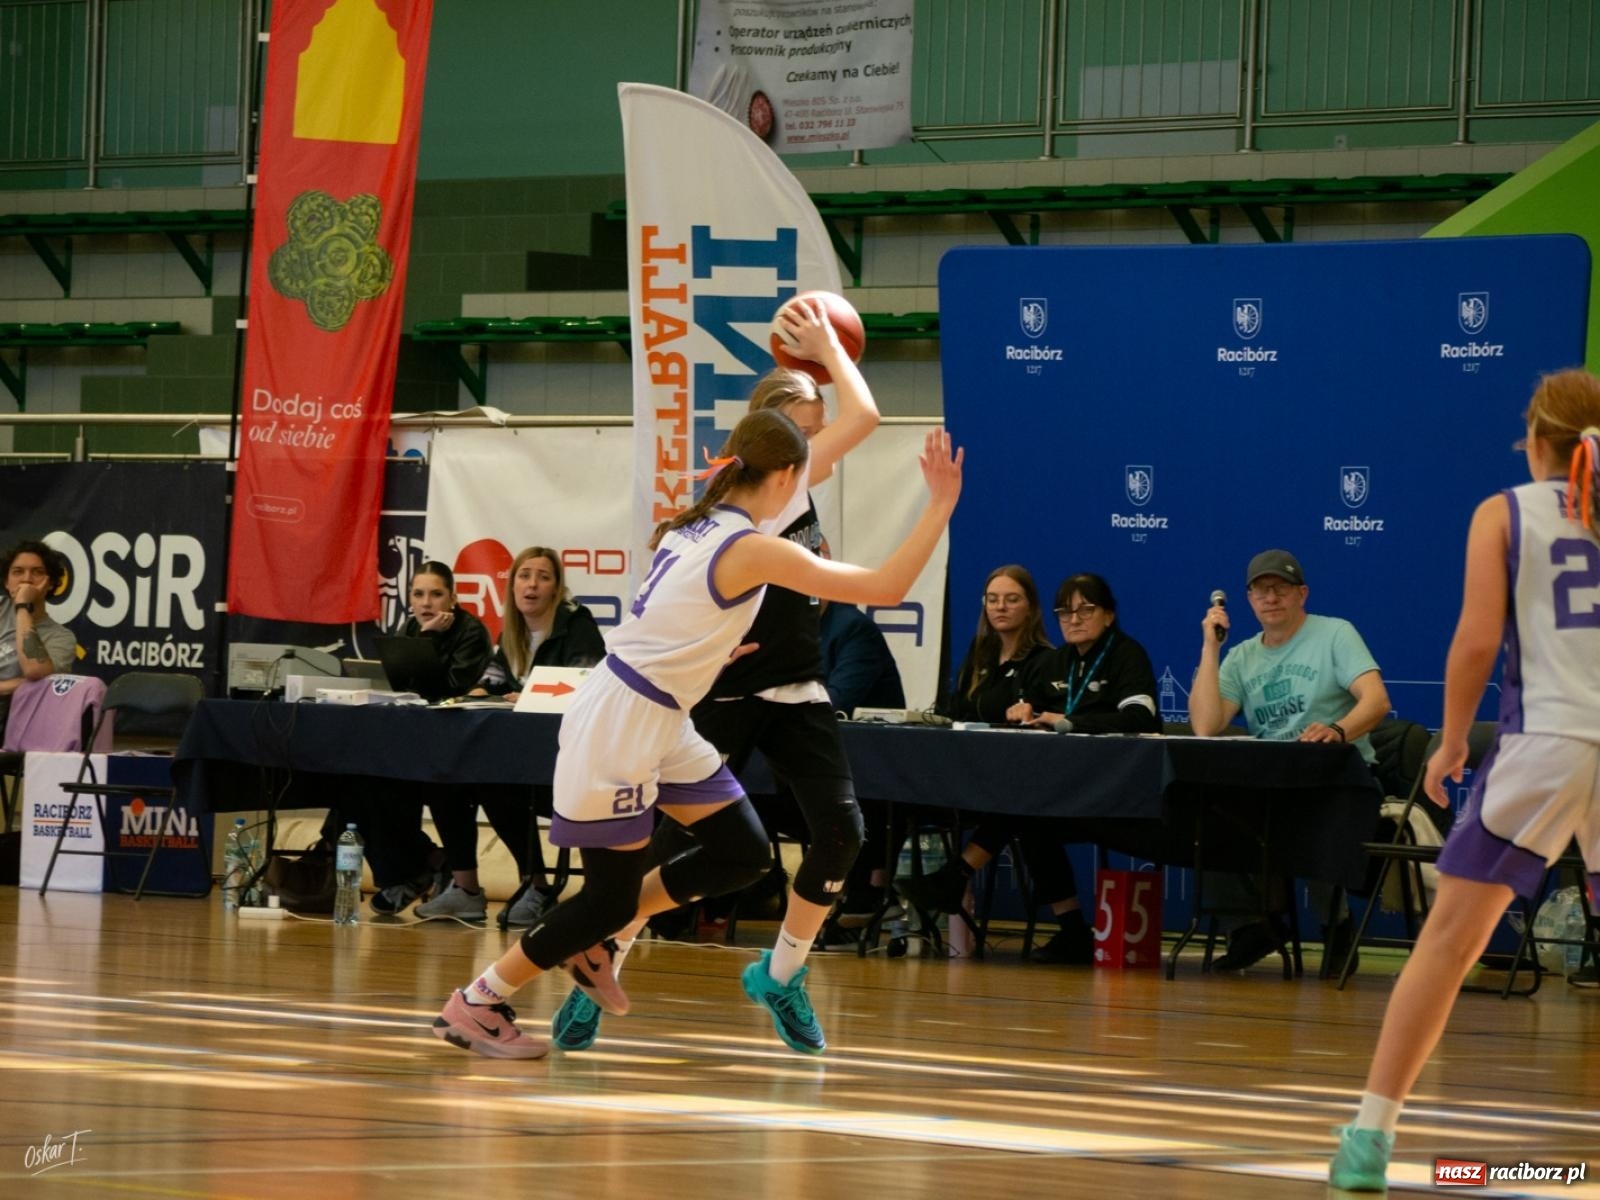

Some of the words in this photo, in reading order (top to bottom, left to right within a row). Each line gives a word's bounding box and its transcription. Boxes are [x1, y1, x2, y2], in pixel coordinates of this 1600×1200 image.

[836, 14, 911, 35] cuerniczych
[730, 44, 785, 56] Pcownik
[786, 70, 837, 82] Czekamy
[842, 68, 859, 79] na
[863, 63, 899, 77] Ciebie!
[1006, 345, 1063, 360] Racibórz
[1217, 347, 1277, 362] Racibórz
[1440, 341, 1504, 358] Racibórz
[253, 389, 322, 423] Dodaj
[330, 396, 362, 419] coś
[249, 421, 278, 442] od
[279, 424, 335, 449] siebie
[1111, 513, 1168, 529] Racibórz
[1324, 516, 1384, 531] Racibórz
[97, 634, 204, 668] RACIBÓRZ
[1254, 694, 1306, 725] DIVSE
[613, 784, 646, 815] 21
[120, 805, 198, 837] MINI
[1091, 879, 1116, 941] 5
[1123, 882, 1152, 943] 5
